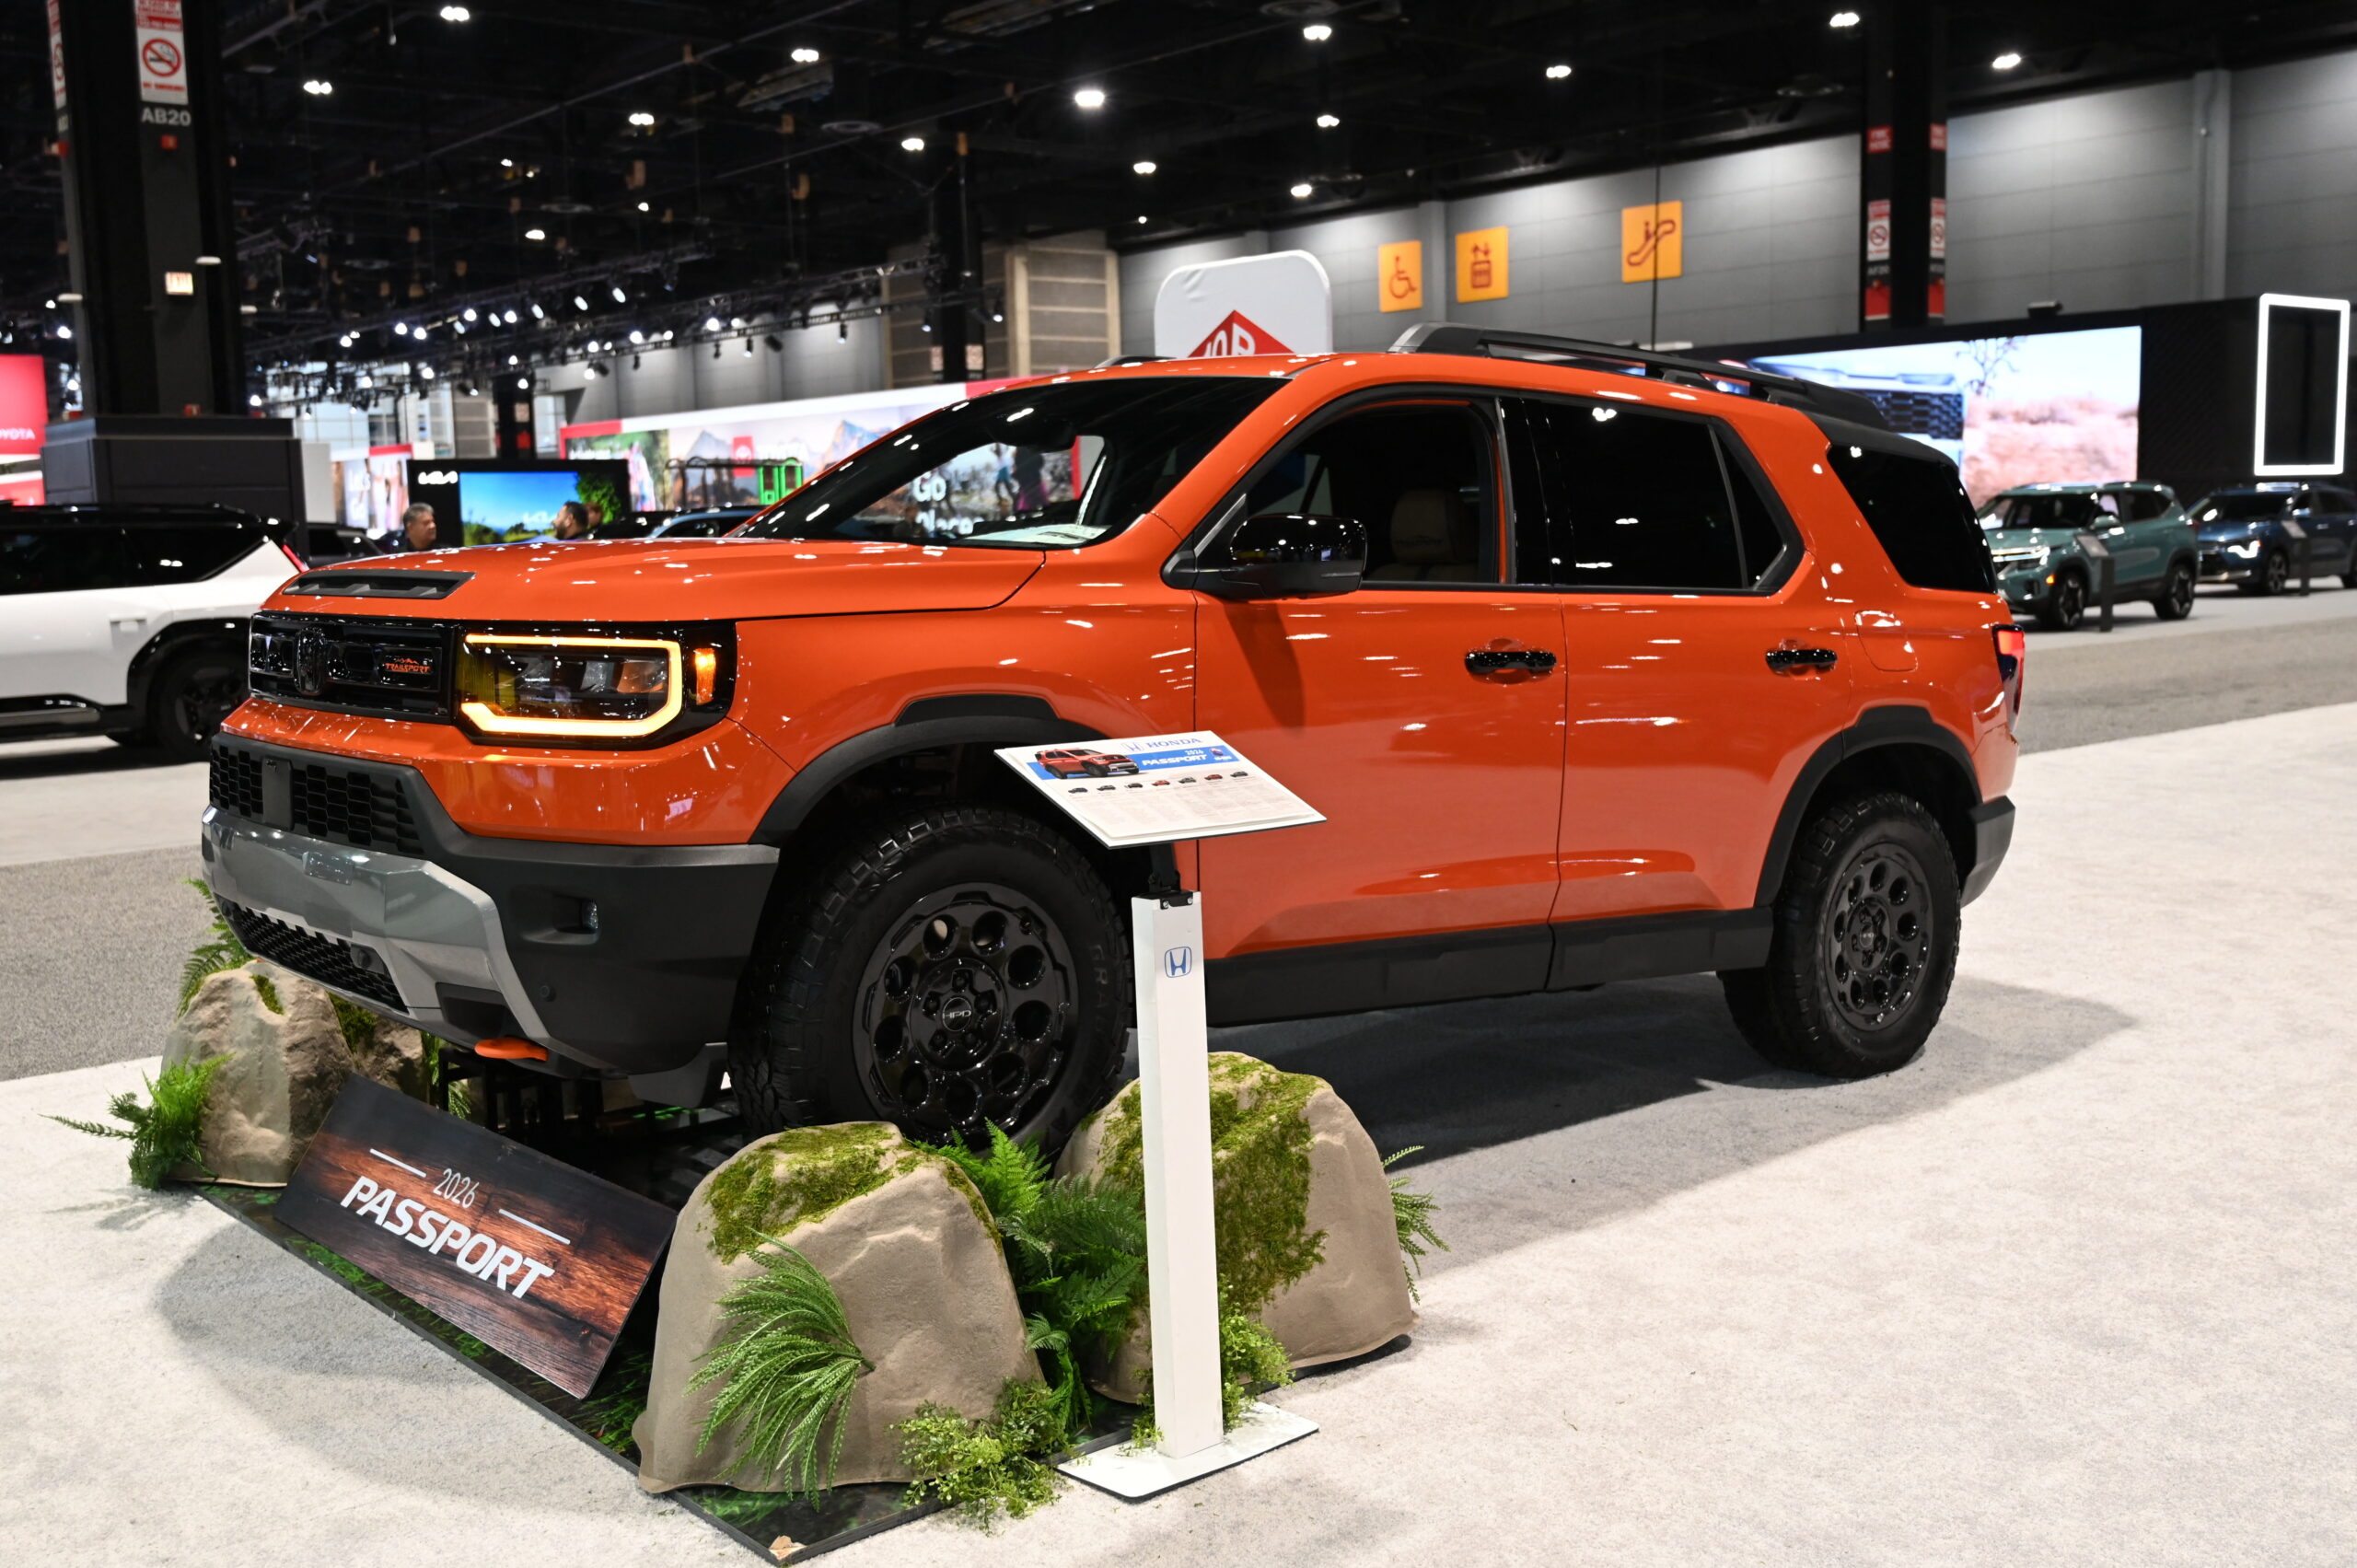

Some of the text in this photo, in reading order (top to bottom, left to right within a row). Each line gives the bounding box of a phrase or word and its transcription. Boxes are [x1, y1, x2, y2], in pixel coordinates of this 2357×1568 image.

[141, 107, 192, 126] AB20
[0, 427, 36, 440] YOTA
[385, 662, 431, 673] TRAILSPORT
[1145, 738, 1202, 749] HONDA
[1142, 754, 1207, 766] PASSPORT
[942, 1009, 972, 1019] HPD
[432, 1167, 480, 1209] 2026
[340, 1175, 556, 1299] PASSPORT
